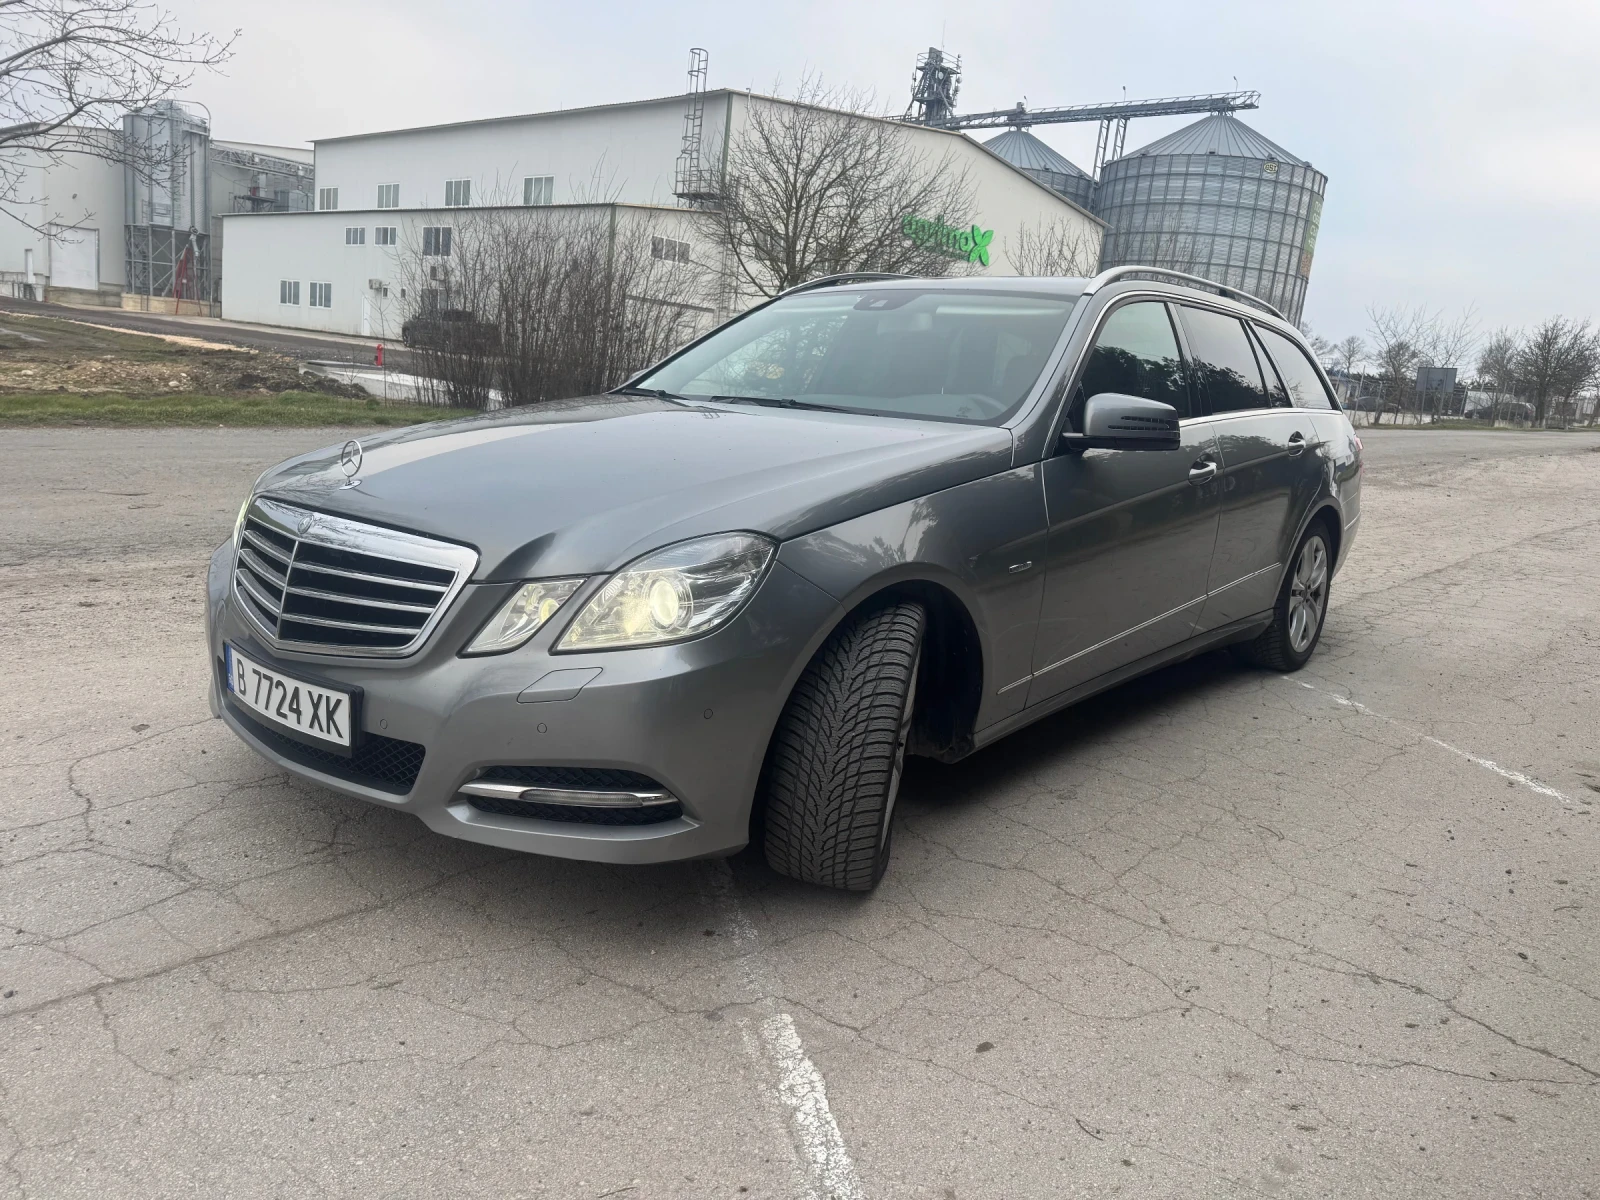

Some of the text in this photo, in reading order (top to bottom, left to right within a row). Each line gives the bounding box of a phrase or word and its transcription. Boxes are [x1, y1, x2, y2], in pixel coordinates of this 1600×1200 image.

[237, 658, 344, 739] B 7724 XK
